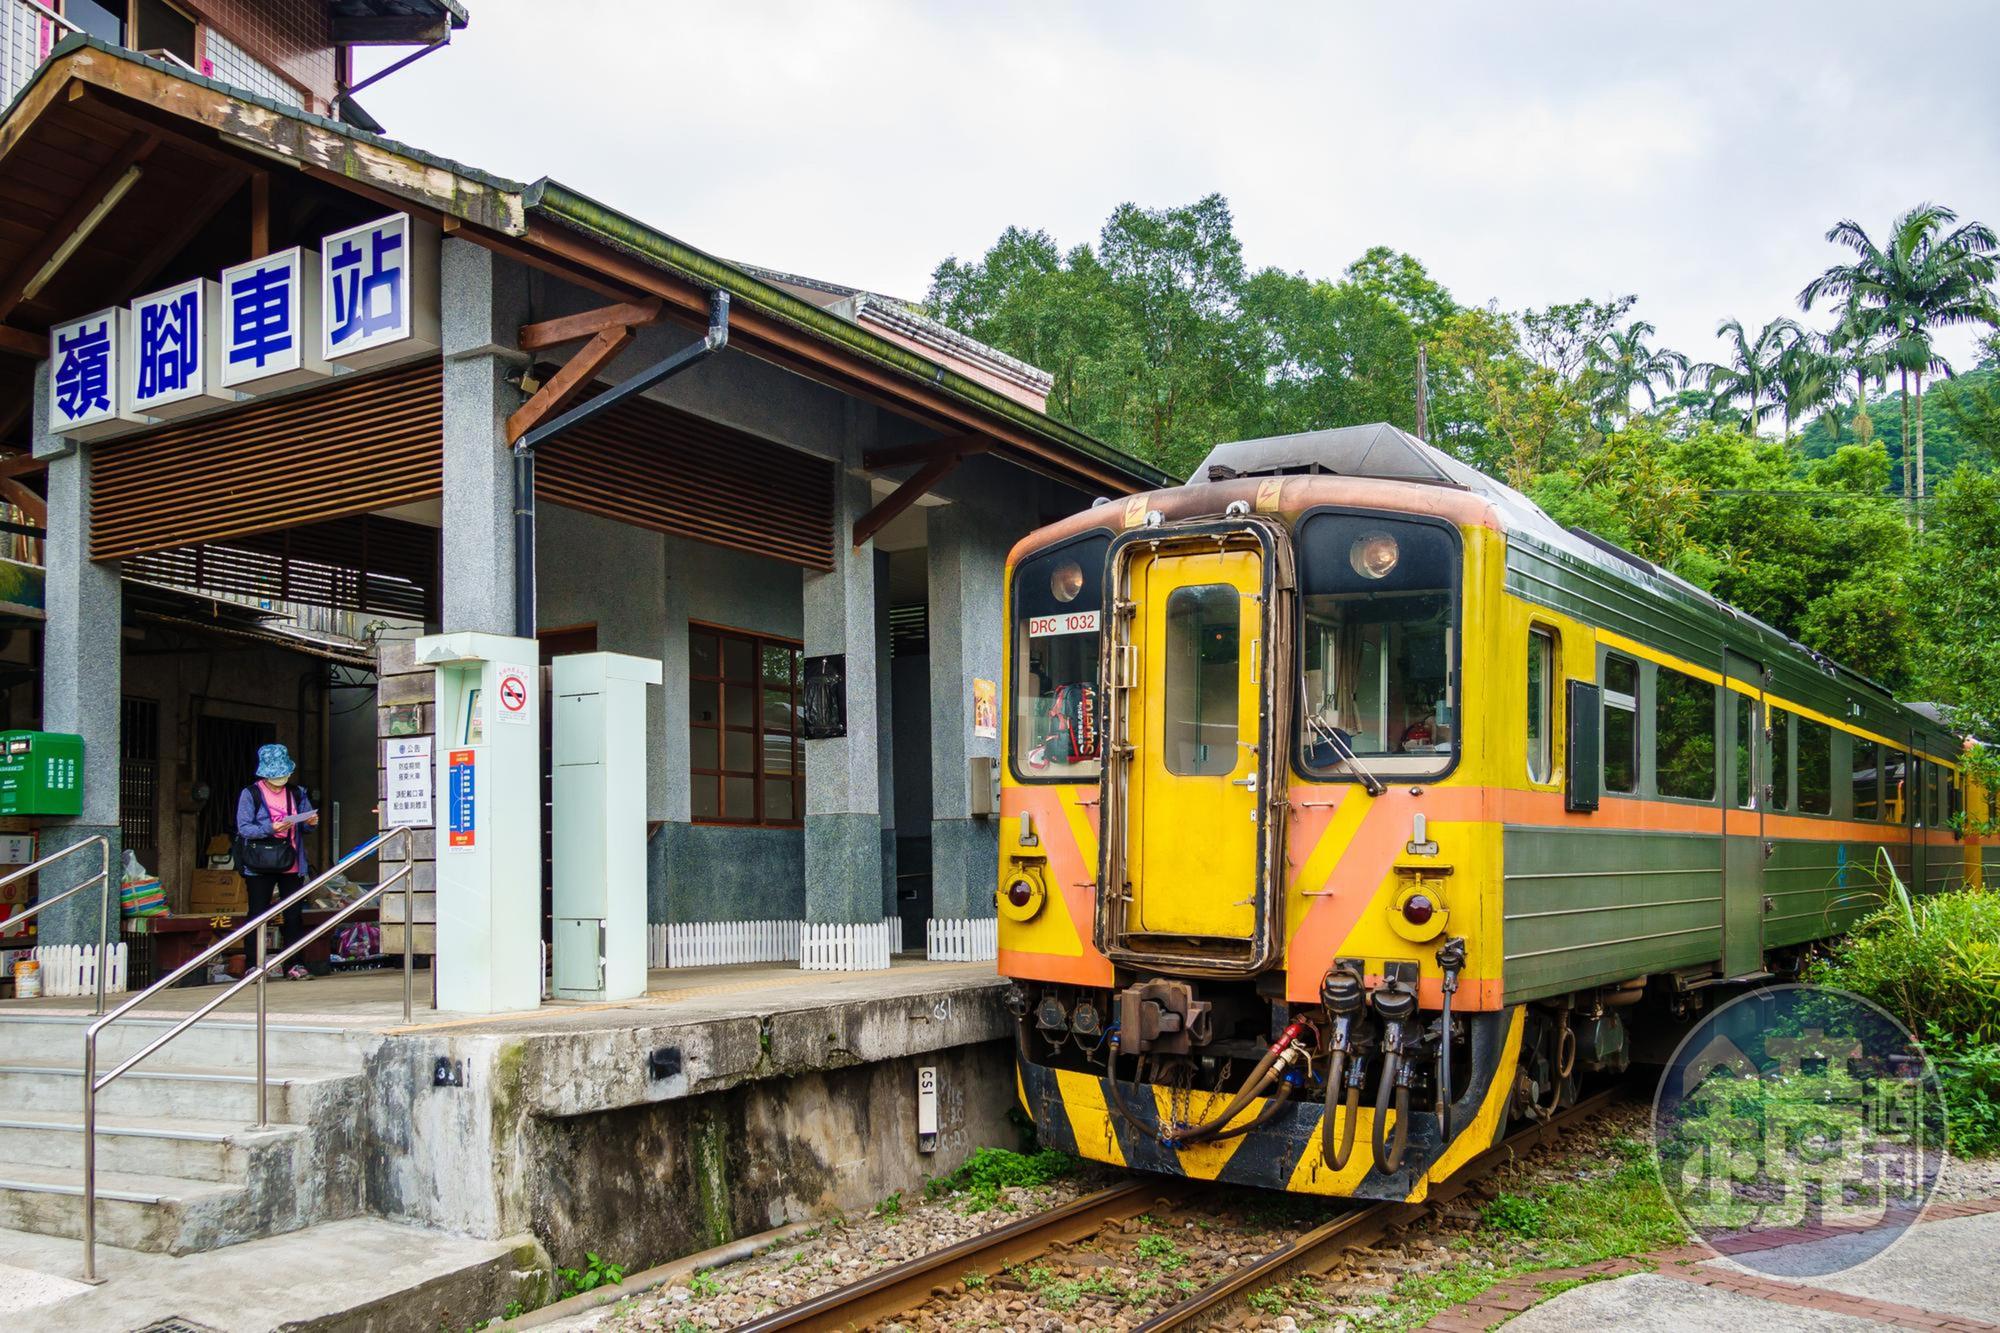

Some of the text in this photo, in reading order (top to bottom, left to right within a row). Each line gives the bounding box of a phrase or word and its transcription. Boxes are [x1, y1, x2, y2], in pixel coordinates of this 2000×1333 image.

[55, 229, 403, 421] 嶺腳車站
[1031, 614, 1095, 634] DRC 1032
